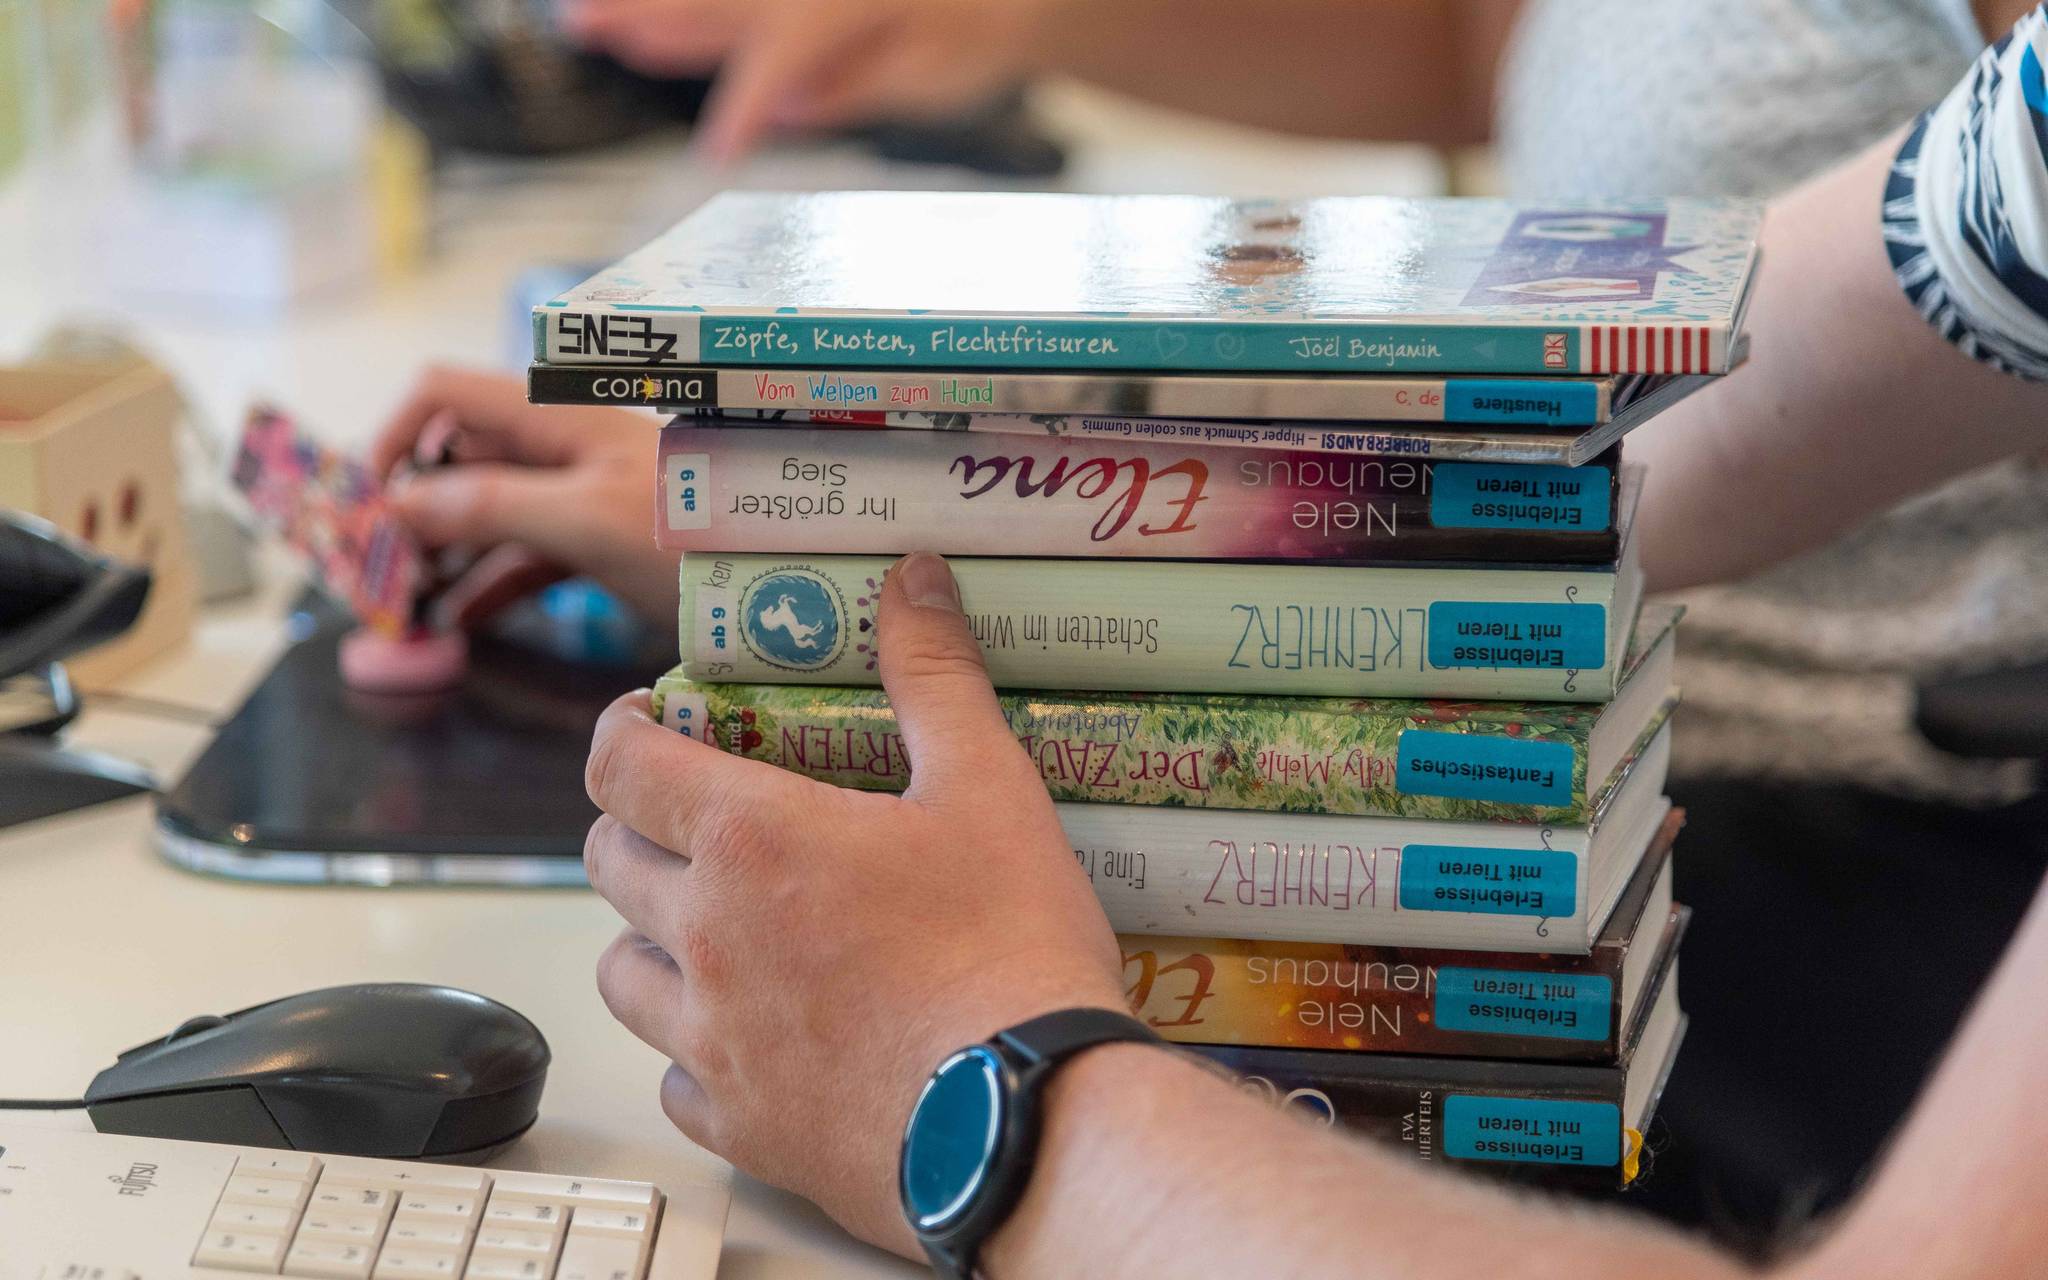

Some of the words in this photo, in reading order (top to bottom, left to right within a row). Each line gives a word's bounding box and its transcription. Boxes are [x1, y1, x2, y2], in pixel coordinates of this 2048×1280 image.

[715, 321, 798, 356] Zöpfe,
[813, 328, 915, 357] Knoten,
[931, 325, 1119, 353] Flechtfrisuren
[1545, 333, 1567, 367] DK
[1289, 336, 1339, 358] Joël
[1348, 337, 1442, 366] Benjamin
[592, 376, 702, 399] corona
[755, 373, 795, 401] Vom
[808, 374, 878, 407] Welpen
[891, 385, 928, 404] zum
[942, 379, 993, 404] Hund
[1473, 398, 1561, 417] Haustiere
[1083, 419, 1132, 436] Gummis
[1136, 422, 1177, 436] coolen
[1180, 425, 1201, 437] aus
[1206, 426, 1259, 443] Schmuck
[1262, 429, 1305, 445] Hipper
[1321, 433, 1430, 453] RUBBERBANDS!
[680, 469, 695, 481] 9
[782, 457, 848, 486] Sieg
[680, 486, 695, 512] ab
[949, 455, 1208, 541] Elena
[1477, 478, 1540, 497] Tieren
[1545, 480, 1580, 497] mit
[729, 491, 844, 520] größter
[857, 497, 896, 520] Ihr
[1472, 502, 1581, 525] Erlebnisse
[1293, 500, 1398, 537] Nele
[711, 607, 726, 618] 9
[711, 627, 726, 649] ab
[1024, 614, 1047, 650] im
[1057, 615, 1158, 654] Schatten
[1228, 604, 1426, 673] LKENHERZ
[1458, 621, 1519, 641] Tieren
[1522, 622, 1562, 640] mit
[1454, 645, 1564, 667] Erlebnisse
[1024, 711, 1141, 742] Abenteuer
[728, 722, 743, 755] and
[1129, 749, 1210, 792] Der
[1256, 750, 1333, 786] Möhle
[1411, 758, 1555, 788] Fantastisches
[1104, 850, 1146, 889] Eine
[1203, 840, 1401, 912] LKENHERZ
[1439, 861, 1504, 881] Tieren
[1510, 863, 1542, 881] mit
[1434, 886, 1543, 909] Erlebnisse
[1474, 979, 1537, 1000] Tieren
[1543, 983, 1576, 1000] mit
[1299, 1001, 1400, 1036] Nele
[1468, 1003, 1577, 1027] Erlebnisse
[1402, 1112, 1415, 1141] EVA
[1419, 1090, 1432, 1161] HIERTEIS
[1478, 1116, 1542, 1136] Tieren
[1548, 1119, 1581, 1136] mit
[1475, 1139, 1584, 1161] Erlebnisse
[117, 1161, 159, 1198] FUJITSU
